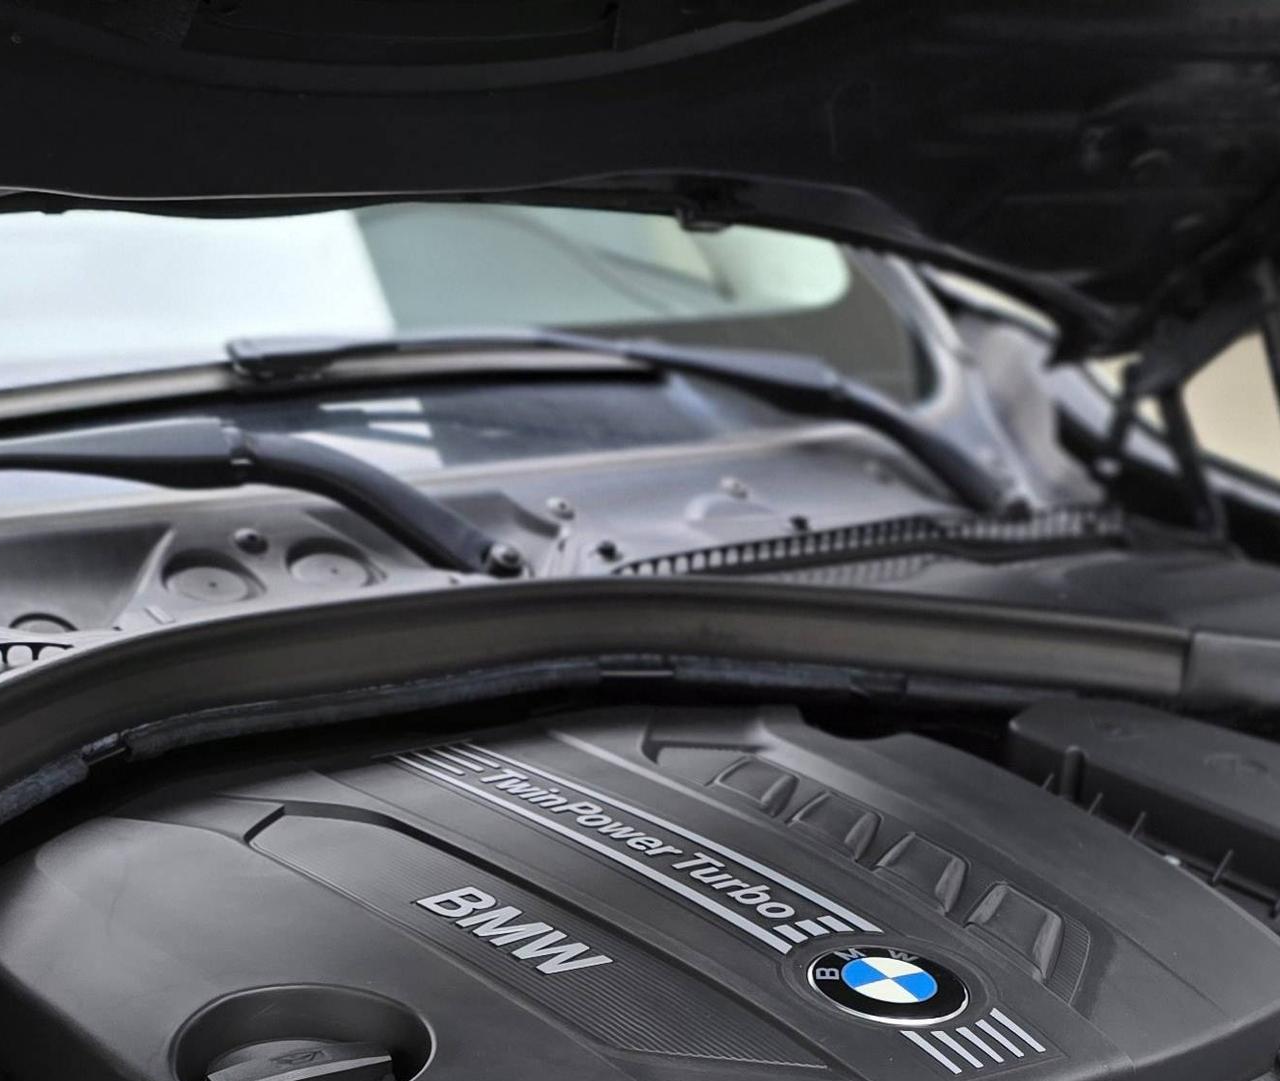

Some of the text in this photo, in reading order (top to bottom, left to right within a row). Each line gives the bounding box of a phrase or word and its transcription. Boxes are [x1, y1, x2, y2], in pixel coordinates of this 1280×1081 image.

[481, 768, 795, 919] TwinPower Turbo
[415, 886, 614, 975] BMW
[815, 947, 919, 981] BMW
